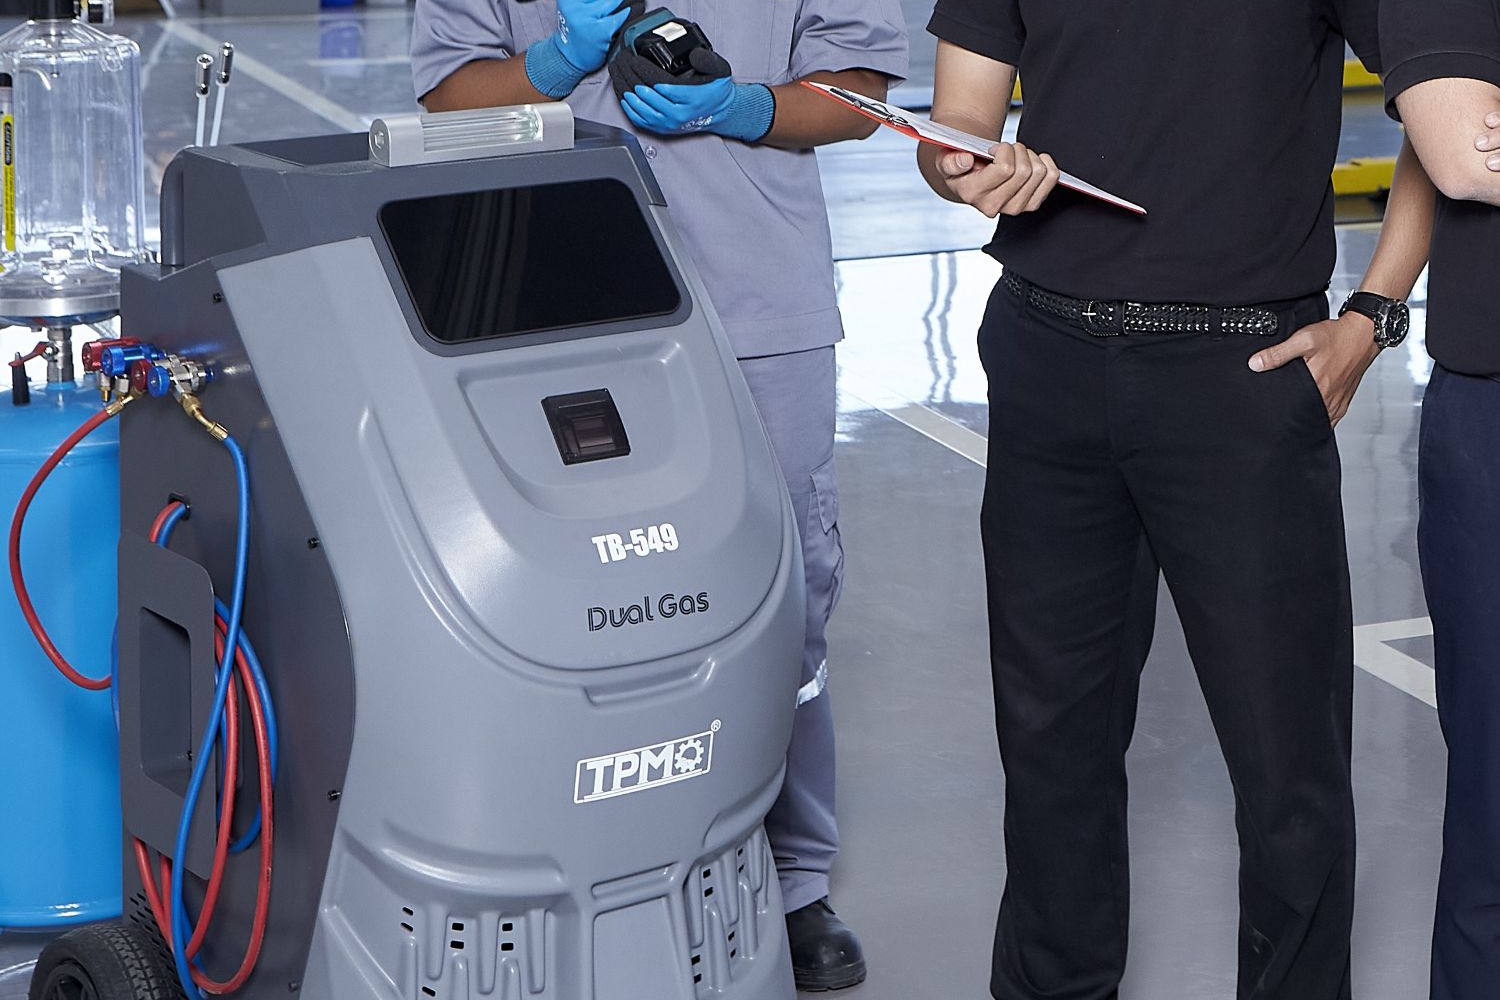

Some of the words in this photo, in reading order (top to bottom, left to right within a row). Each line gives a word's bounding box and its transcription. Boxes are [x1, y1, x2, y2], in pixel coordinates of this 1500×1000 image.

[591, 522, 679, 564] TB-549
[587, 596, 654, 632] Dual
[657, 592, 710, 618] Gas
